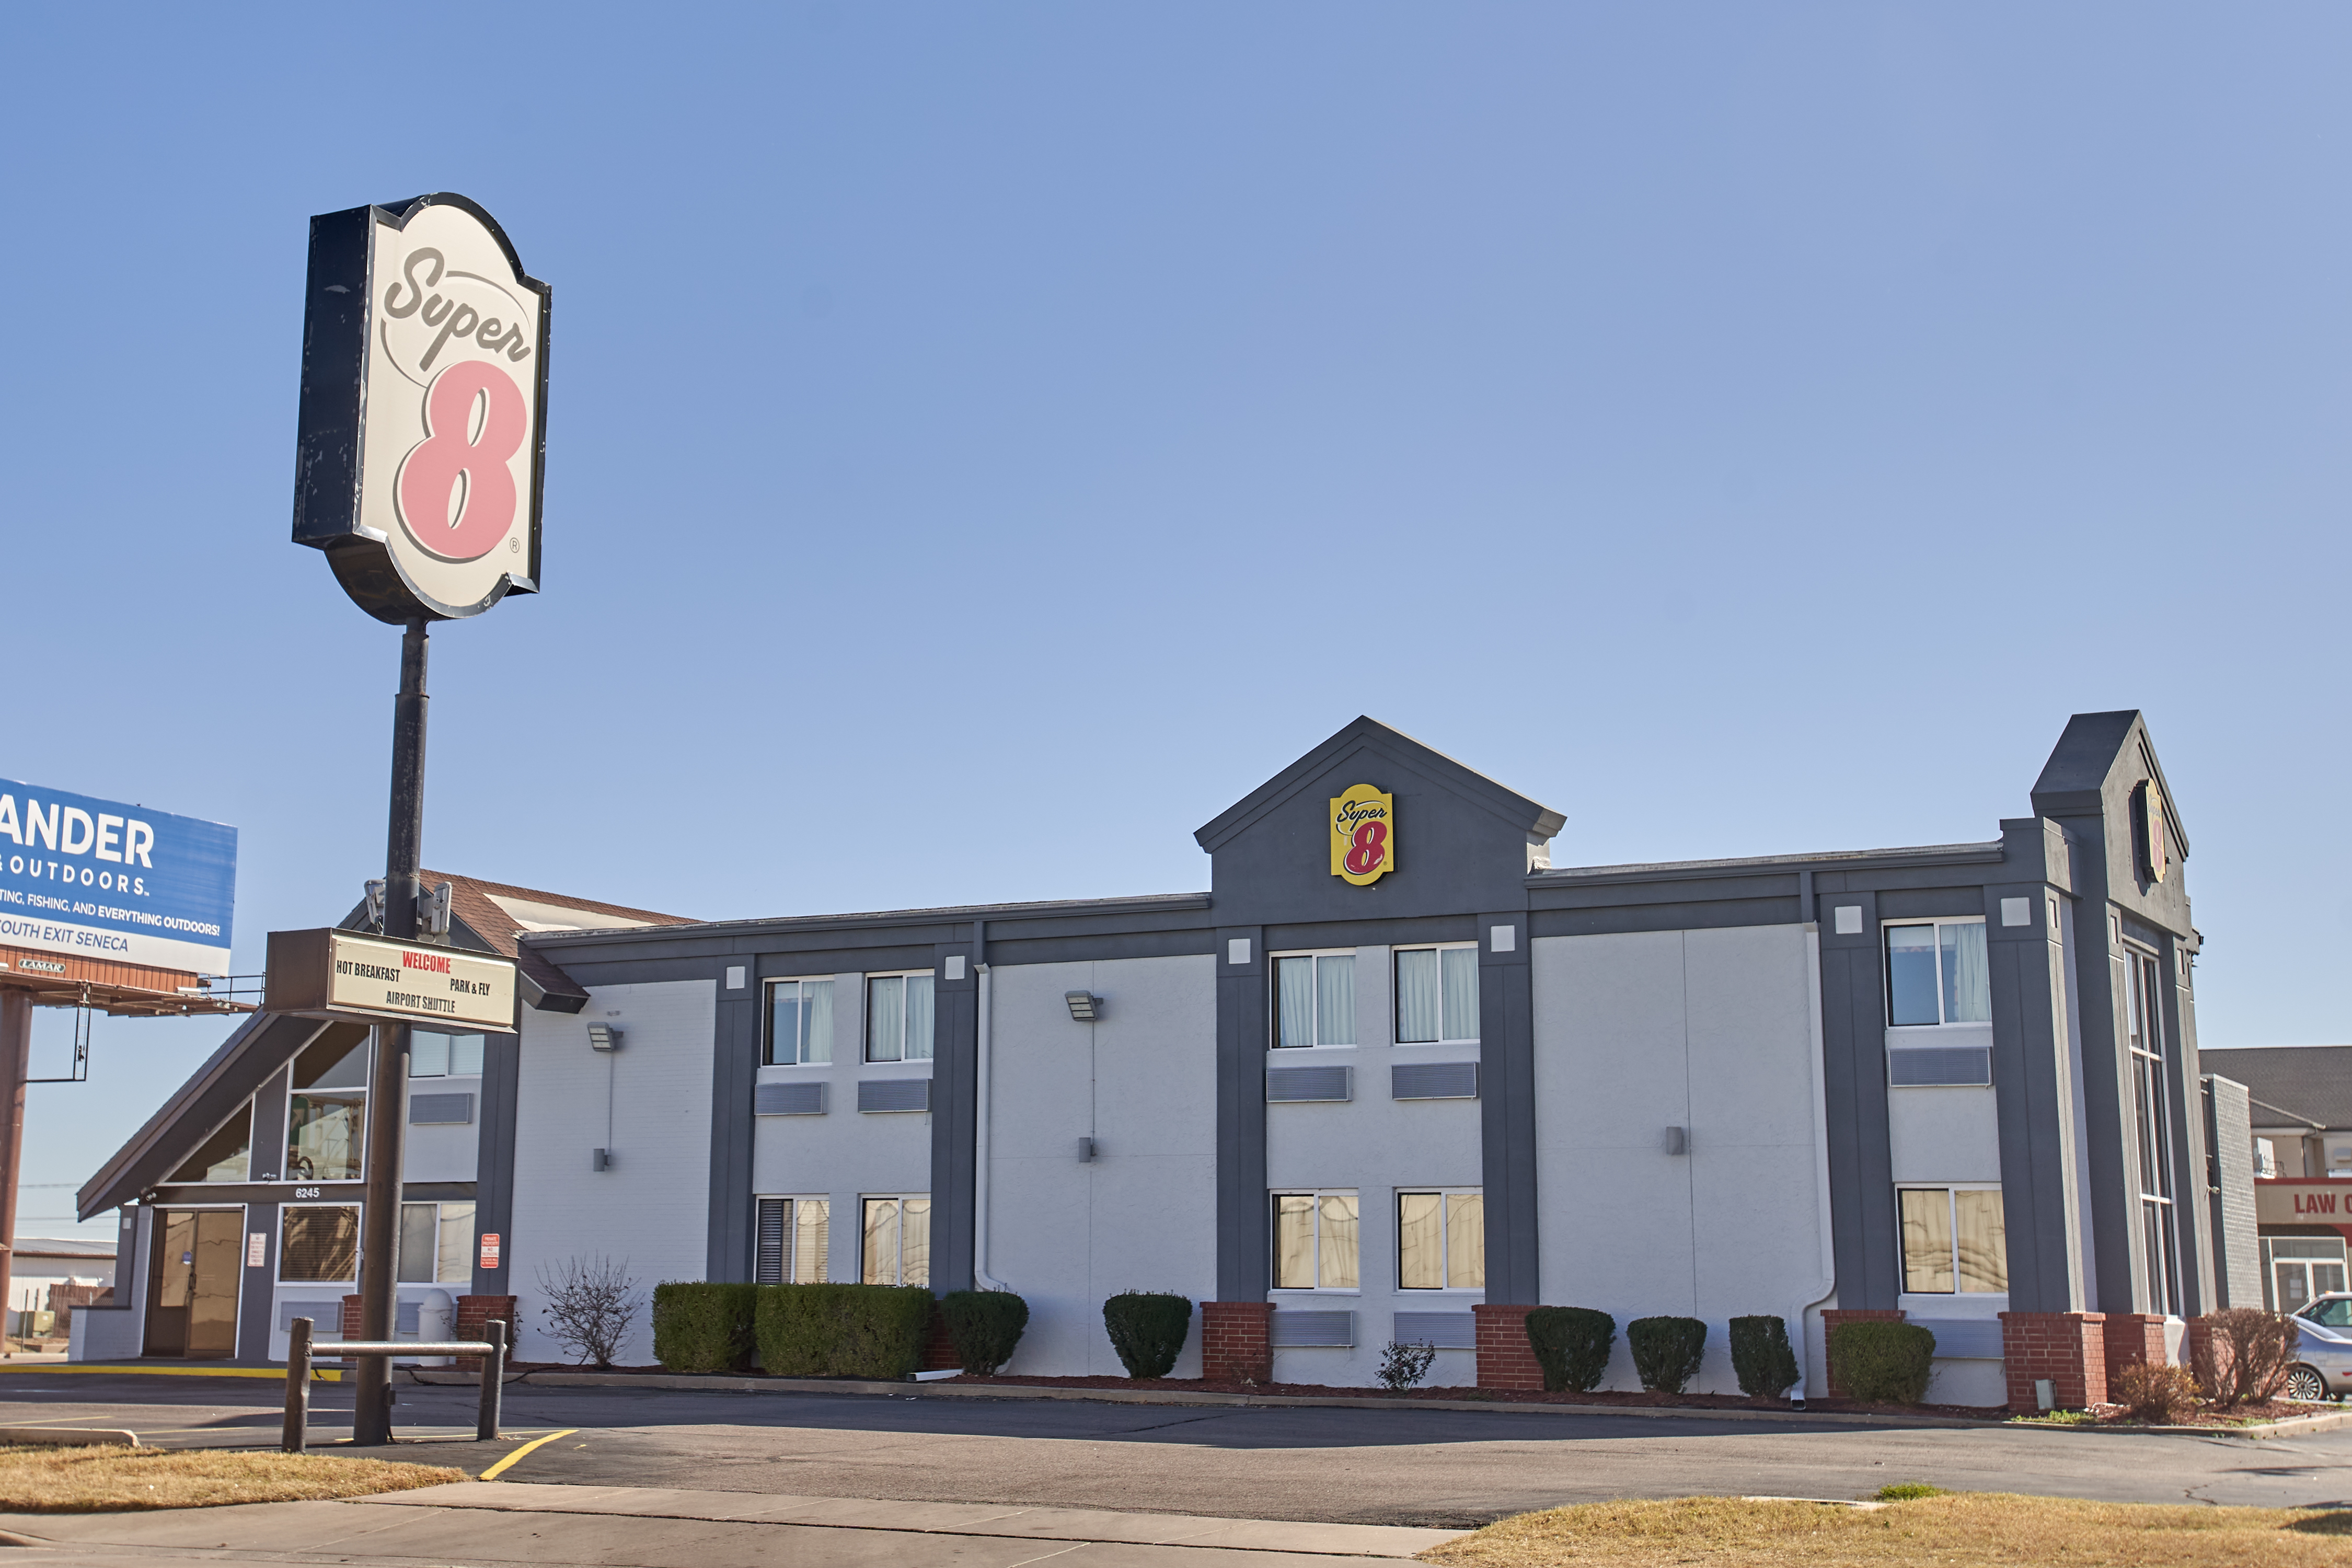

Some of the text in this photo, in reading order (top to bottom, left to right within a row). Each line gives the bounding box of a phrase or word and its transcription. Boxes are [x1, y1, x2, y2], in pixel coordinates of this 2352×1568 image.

[384, 247, 531, 373] Super
[393, 360, 527, 563] 8
[1336, 800, 1387, 832] Super
[1344, 821, 1387, 875] 8
[2153, 819, 2163, 872] 8
[28, 893, 70, 913] FISHING,
[72, 901, 96, 916] AND
[98, 905, 162, 927] EVERYTHING
[163, 916, 220, 937] OUTDOORS!
[43, 926, 74, 943] EXIT
[76, 931, 128, 952] SENECA
[22, 960, 62, 972] LAMAR
[337, 960, 490, 996] HOT BREAKFAST PARK & FLY
[402, 950, 451, 974] WELCOME
[386, 990, 455, 1013] AIRPORT SHUTTLE
[295, 1187, 320, 1198] 6245
[2294, 1193, 2336, 1214] LAW
